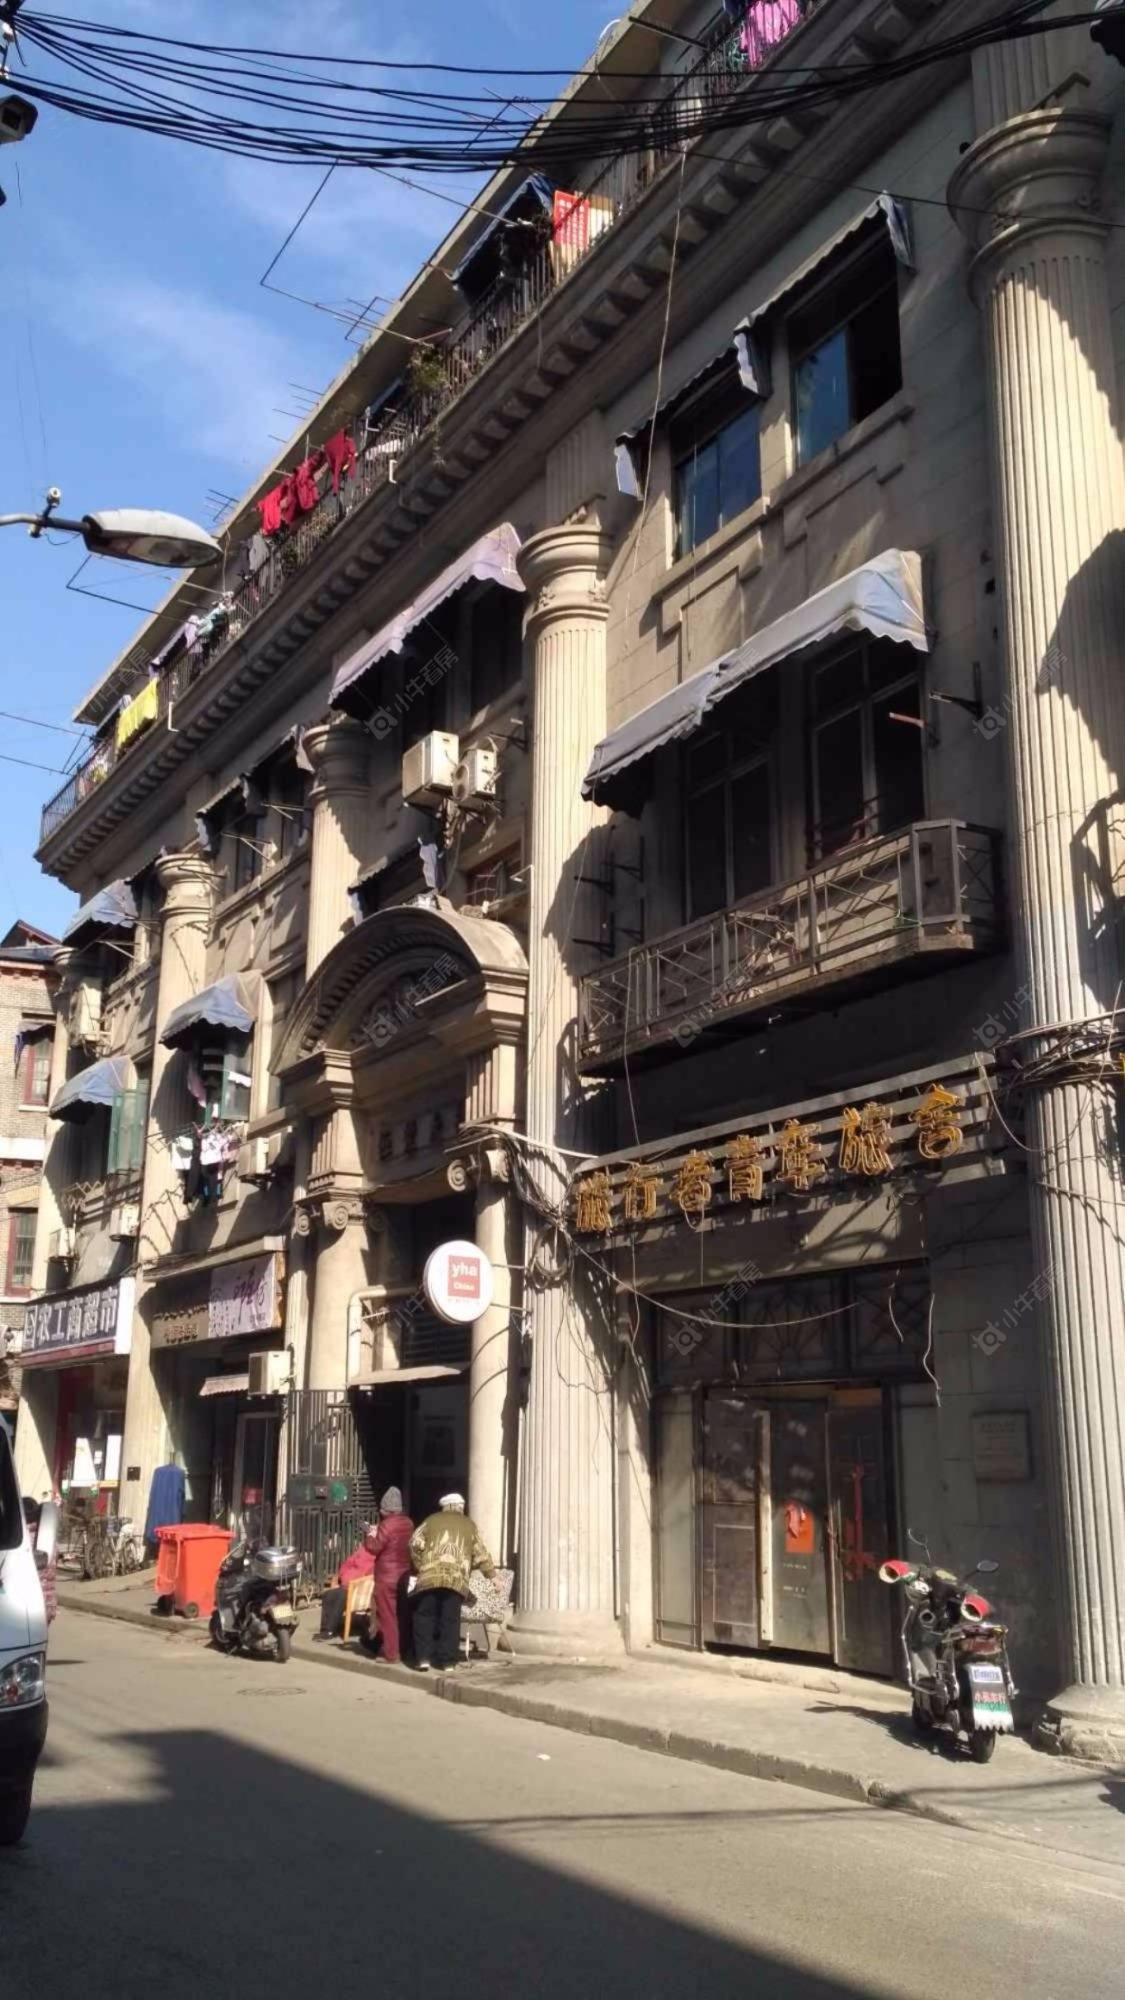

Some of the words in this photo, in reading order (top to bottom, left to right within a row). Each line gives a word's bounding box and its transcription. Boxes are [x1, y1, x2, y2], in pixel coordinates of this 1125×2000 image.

[576, 1083, 966, 1232] 旅行者青年旅舍
[451, 1261, 478, 1278] yha
